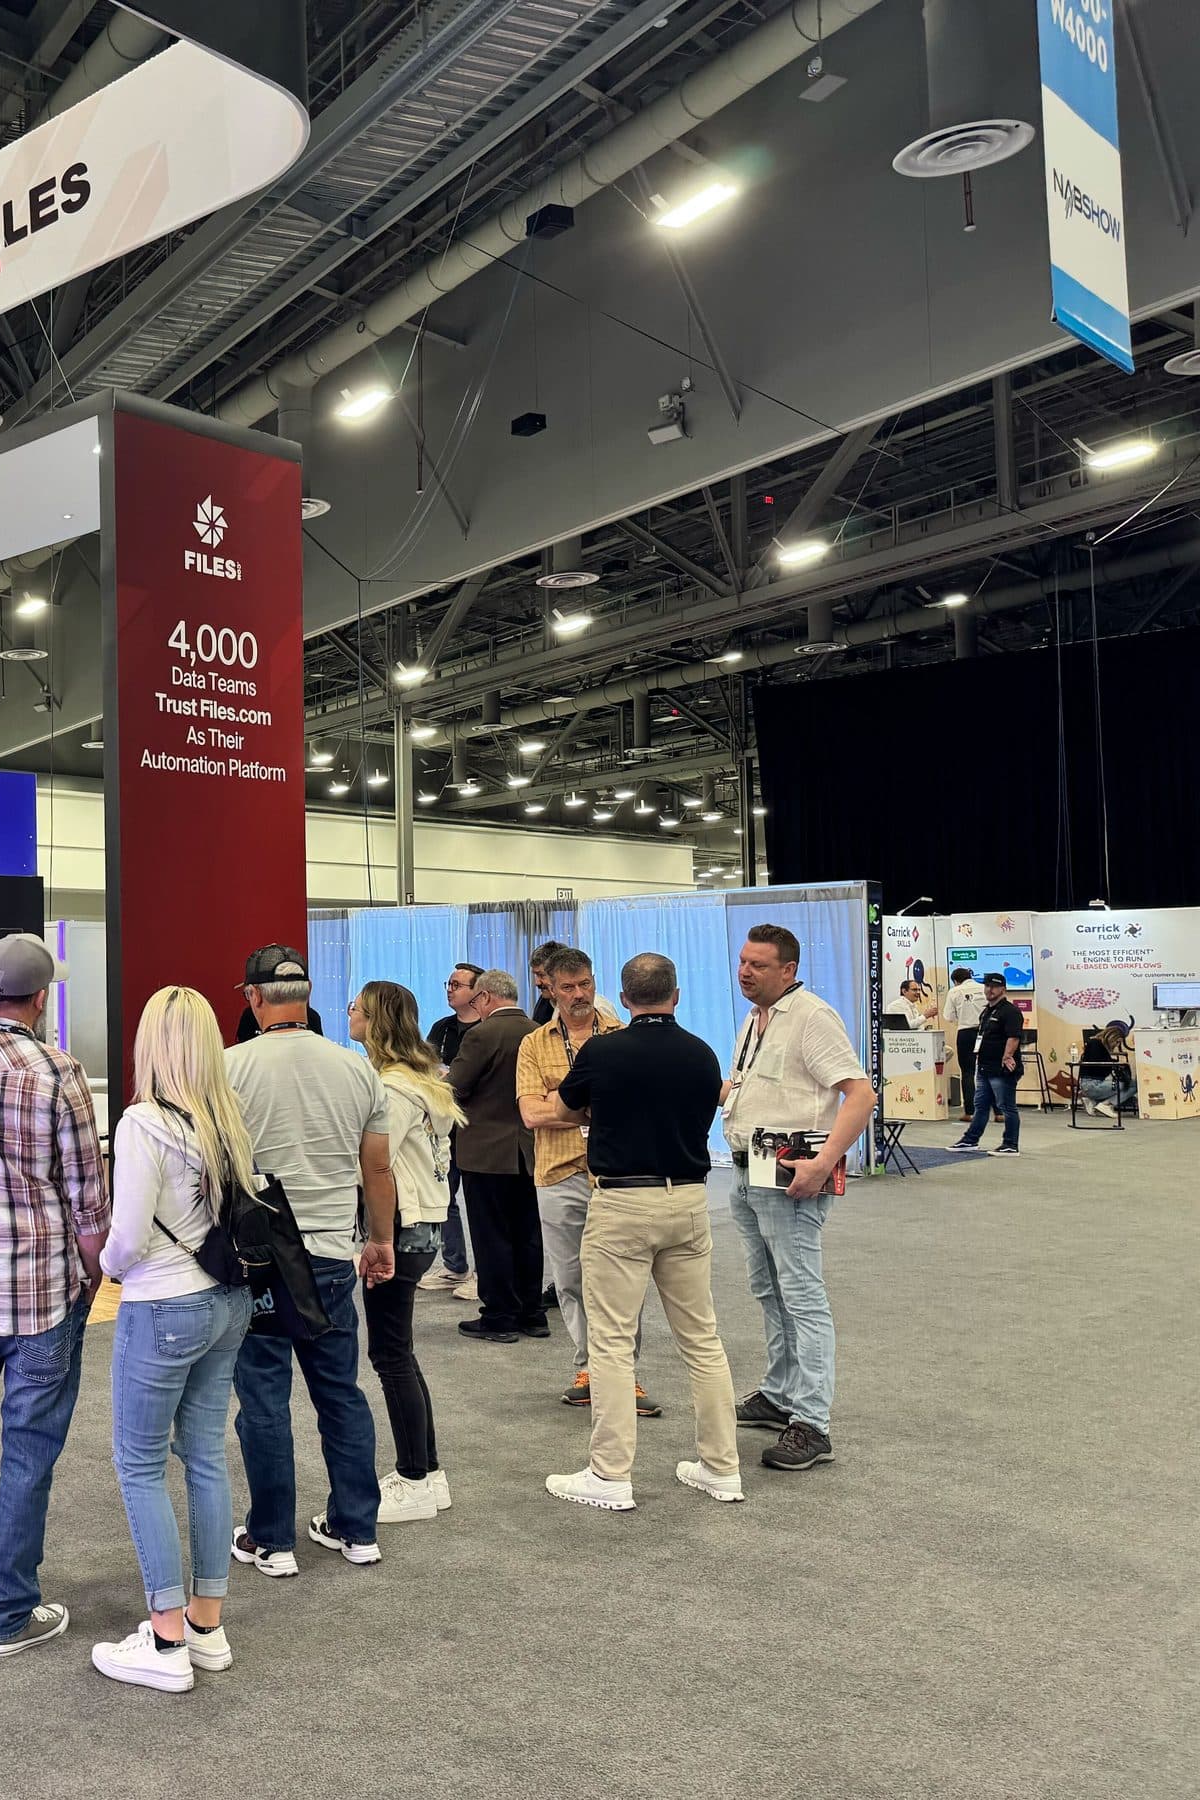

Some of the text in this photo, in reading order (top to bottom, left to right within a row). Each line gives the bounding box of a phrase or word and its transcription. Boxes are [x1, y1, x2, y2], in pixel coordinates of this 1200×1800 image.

[1050, 0, 1107, 72] W4000
[184, 550, 237, 580] FILES
[167, 620, 258, 669] 4,000
[172, 666, 257, 697] Data Teams
[155, 692, 272, 726] Trust Files.com
[186, 726, 245, 750] As Their
[140, 749, 286, 783] Automation Platform
[887, 926, 911, 938] Carrick
[1076, 923, 1120, 934] Carrick
[870, 940, 878, 978] Bring
